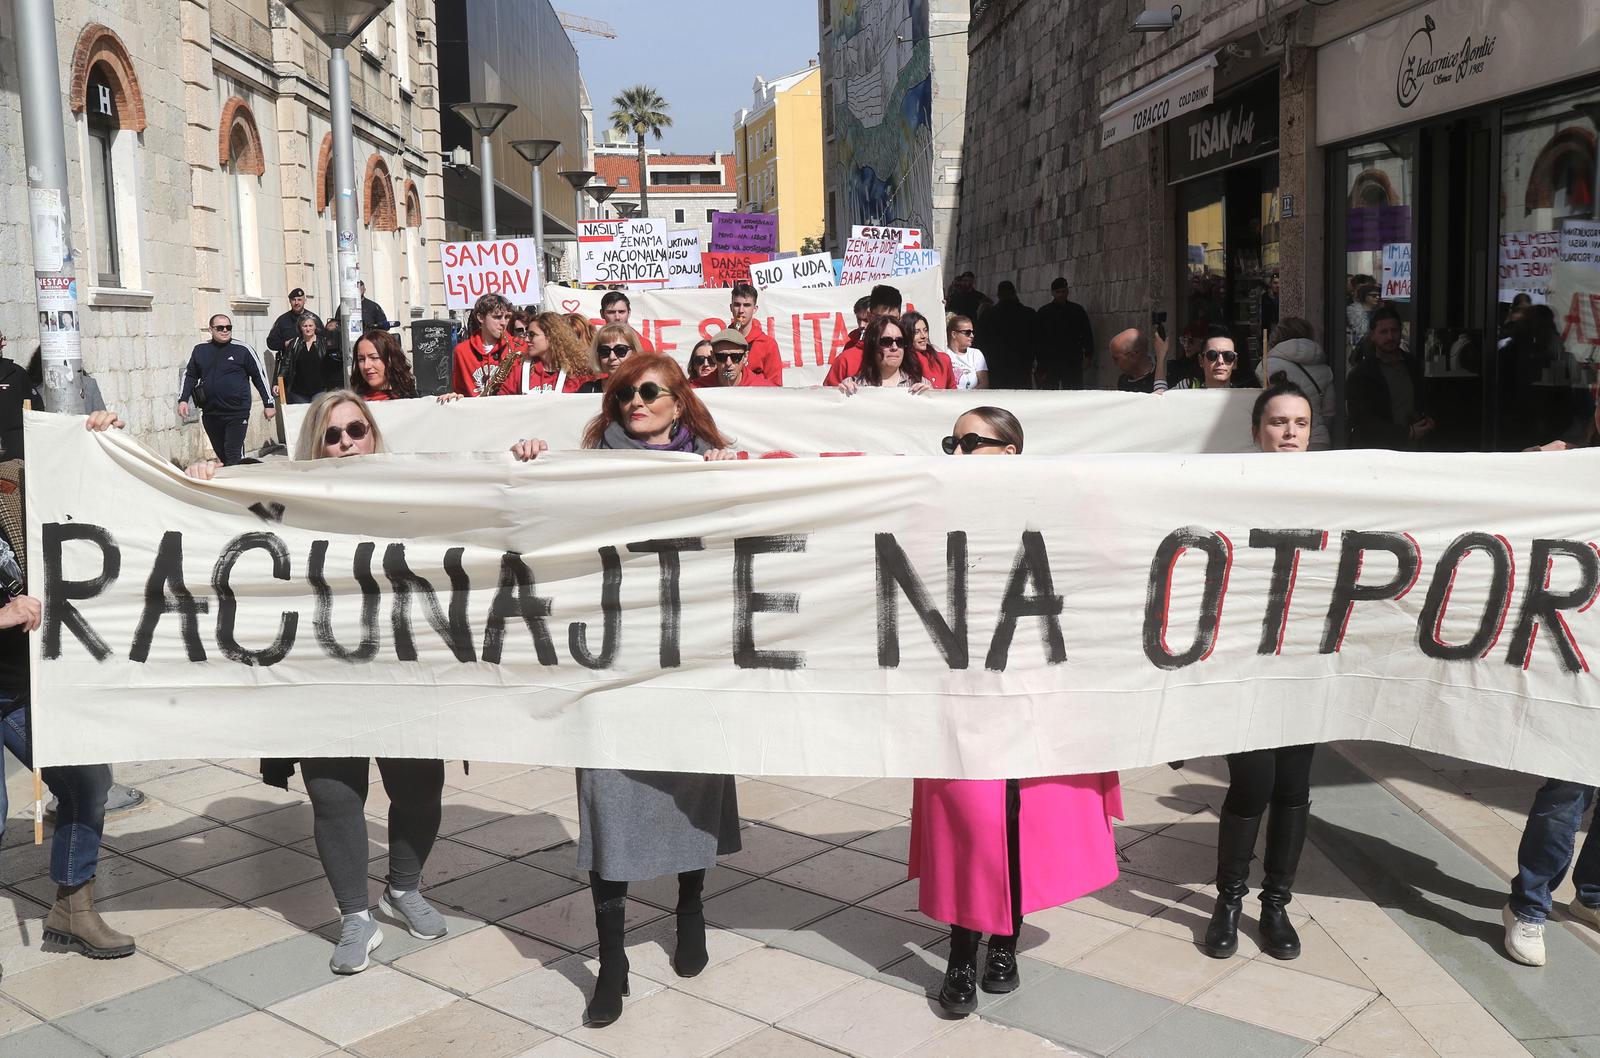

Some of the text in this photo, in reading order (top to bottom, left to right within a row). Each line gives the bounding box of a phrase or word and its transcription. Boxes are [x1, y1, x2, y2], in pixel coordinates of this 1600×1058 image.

[97, 84, 113, 116] H
[1132, 98, 1170, 131] TOBACCO
[1188, 109, 1231, 161] TISAK
[584, 222, 653, 237] NASILJE NAD
[861, 227, 903, 243] SRAM
[620, 235, 663, 248] ŽENAMA
[445, 242, 519, 268] SAMO
[585, 248, 668, 263] JE NACIONALNA
[921, 250, 934, 265] MI
[595, 262, 665, 282] SRAMOTA
[755, 266, 783, 286] BILO
[792, 259, 831, 279] KUDA,
[42, 501, 1600, 673] RAČUNAJTE NA OTPOR
